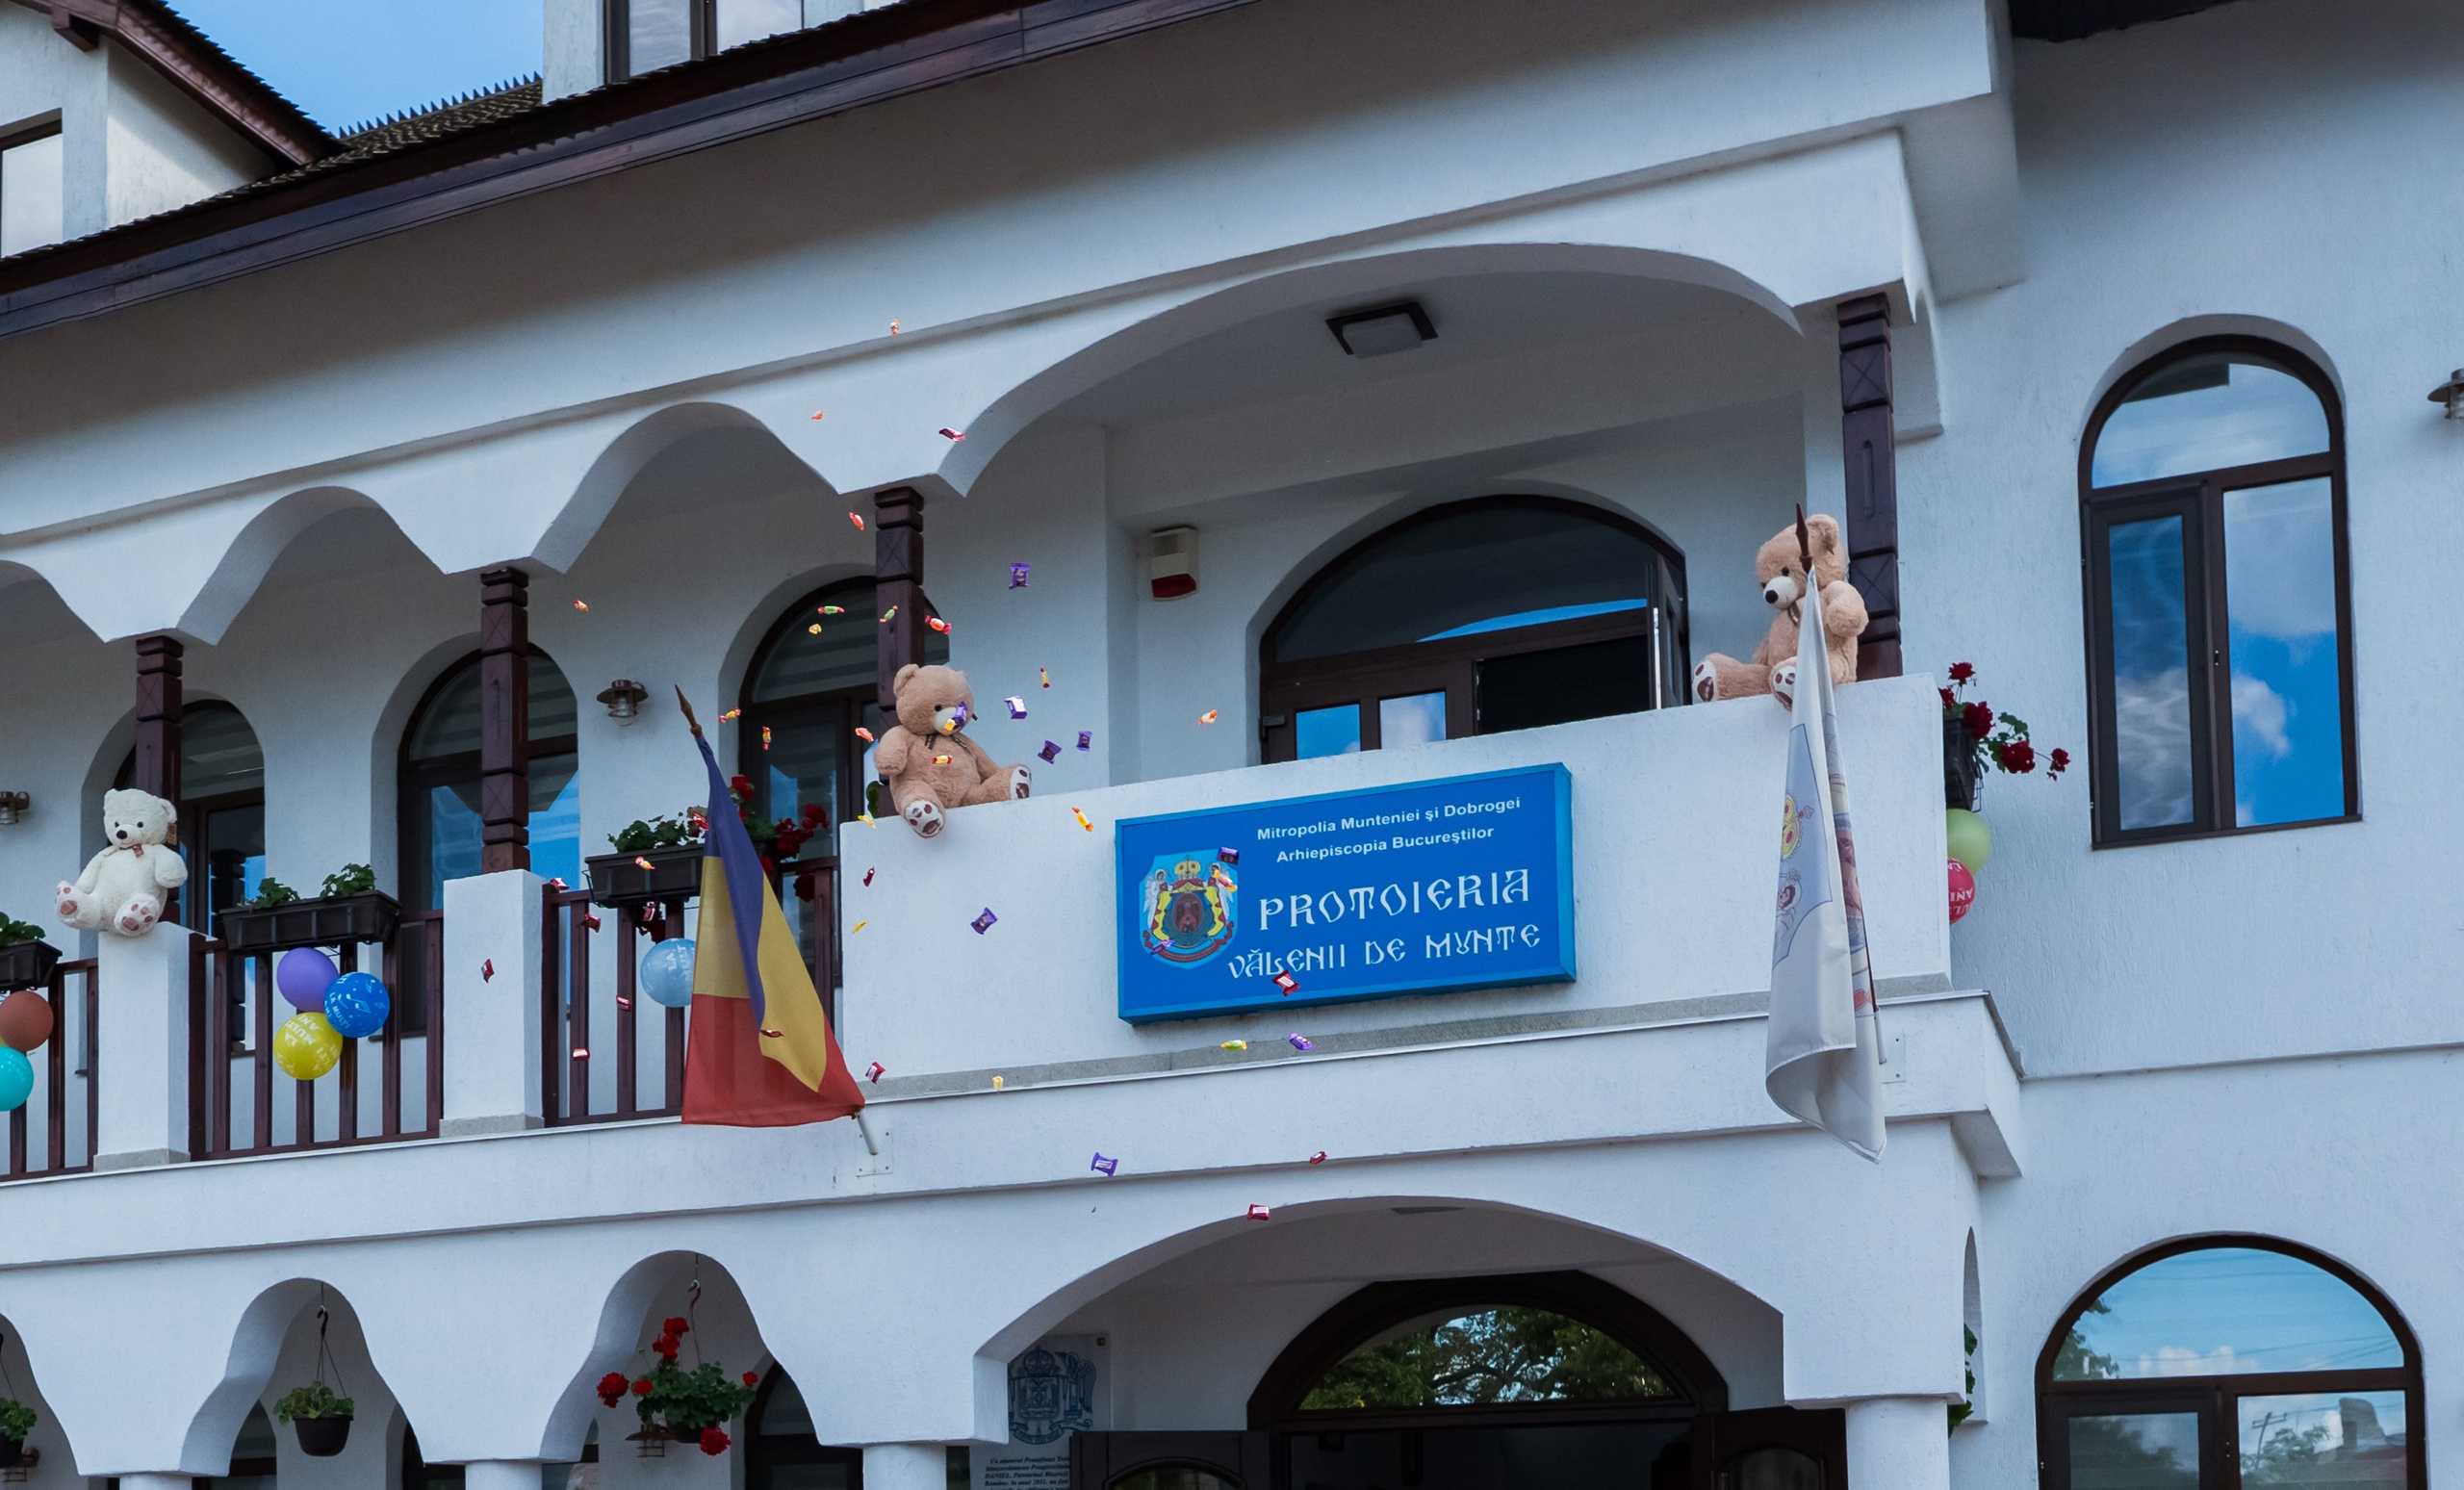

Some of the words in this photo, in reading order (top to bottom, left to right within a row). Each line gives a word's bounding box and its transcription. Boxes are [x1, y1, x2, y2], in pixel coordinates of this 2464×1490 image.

[1257, 821, 1336, 840] Mitropolia
[1341, 809, 1420, 830] Munteniei
[1444, 796, 1521, 817] Dobrogei
[1276, 839, 1387, 862] Arhiepiscopia
[1260, 868, 1529, 931] PROTOIERIA
[1228, 944, 1345, 979] VĂLENII
[1365, 938, 1405, 964] DE
[1425, 924, 1540, 959] MUNTE
